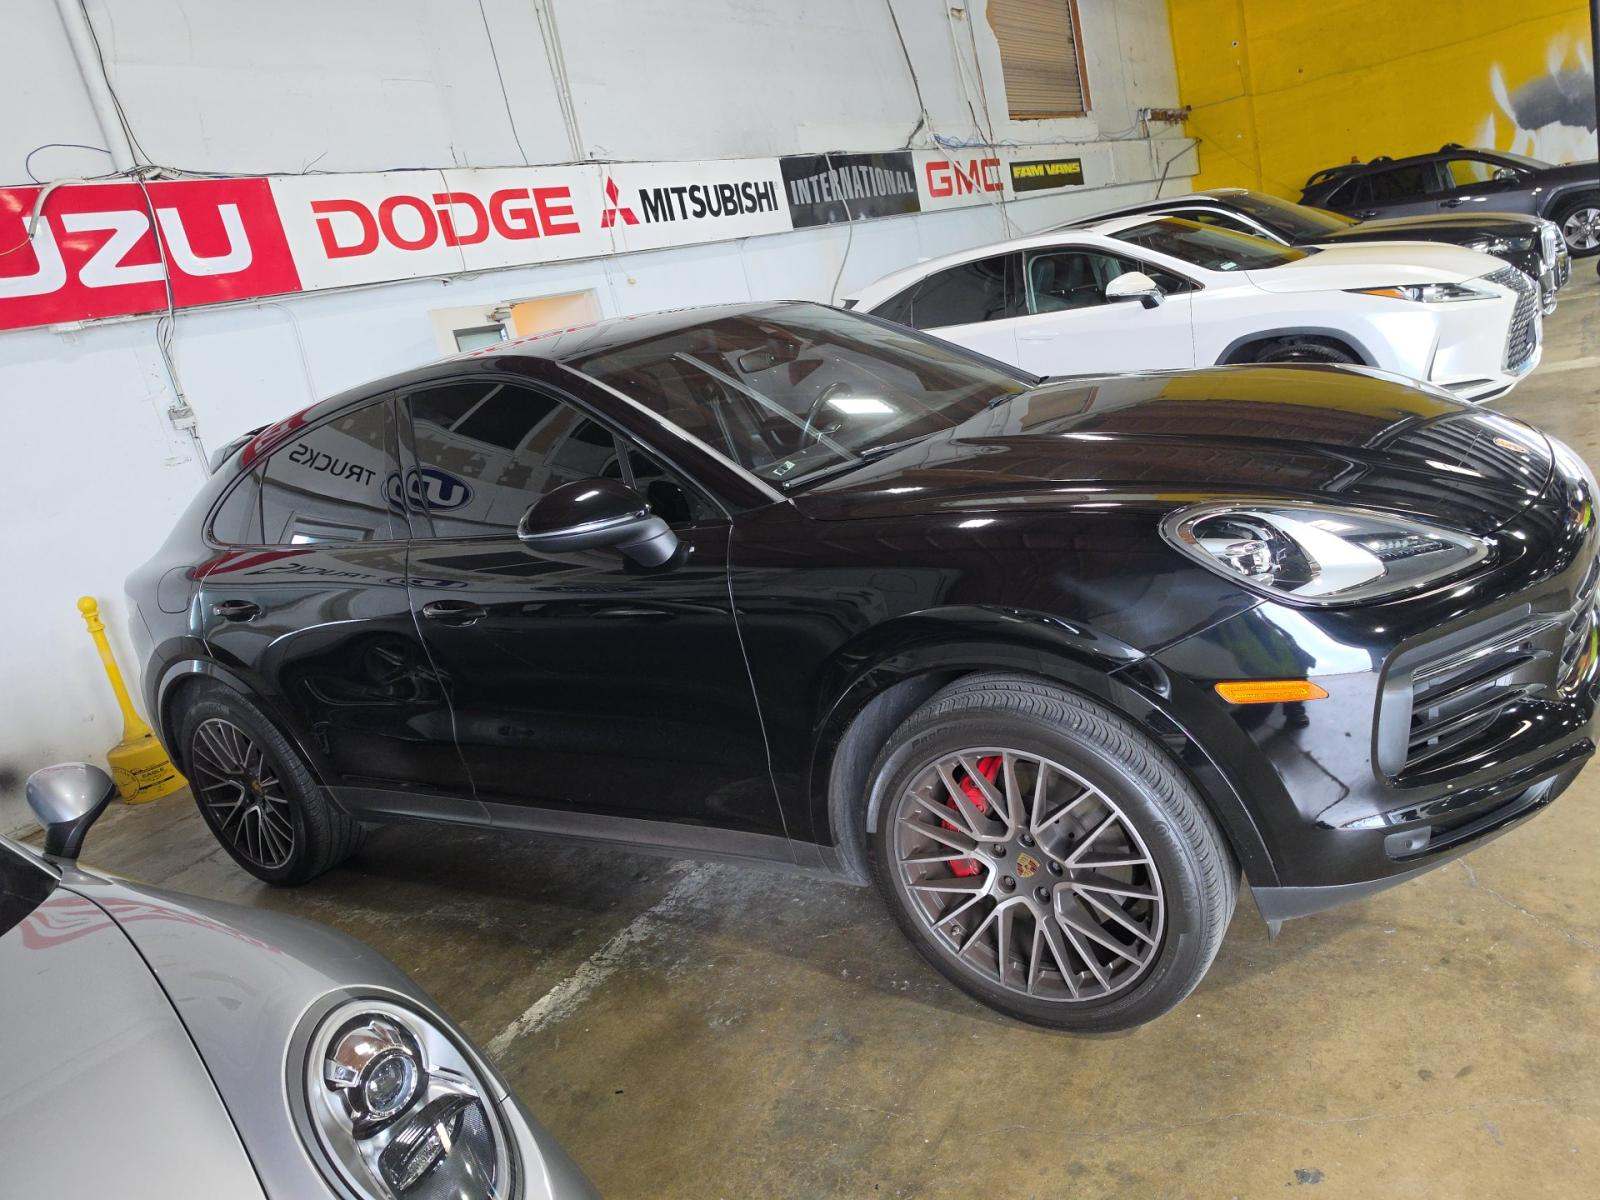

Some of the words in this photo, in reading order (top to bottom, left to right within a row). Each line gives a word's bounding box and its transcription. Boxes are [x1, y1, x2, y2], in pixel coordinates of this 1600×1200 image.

[790, 165, 914, 205] INTERNATIONAL
[925, 159, 1004, 198] GMC
[1013, 164, 1044, 178] FAM
[1045, 162, 1081, 175] VANS
[638, 181, 778, 223] MITSUBISHI
[310, 186, 580, 259] DODGE
